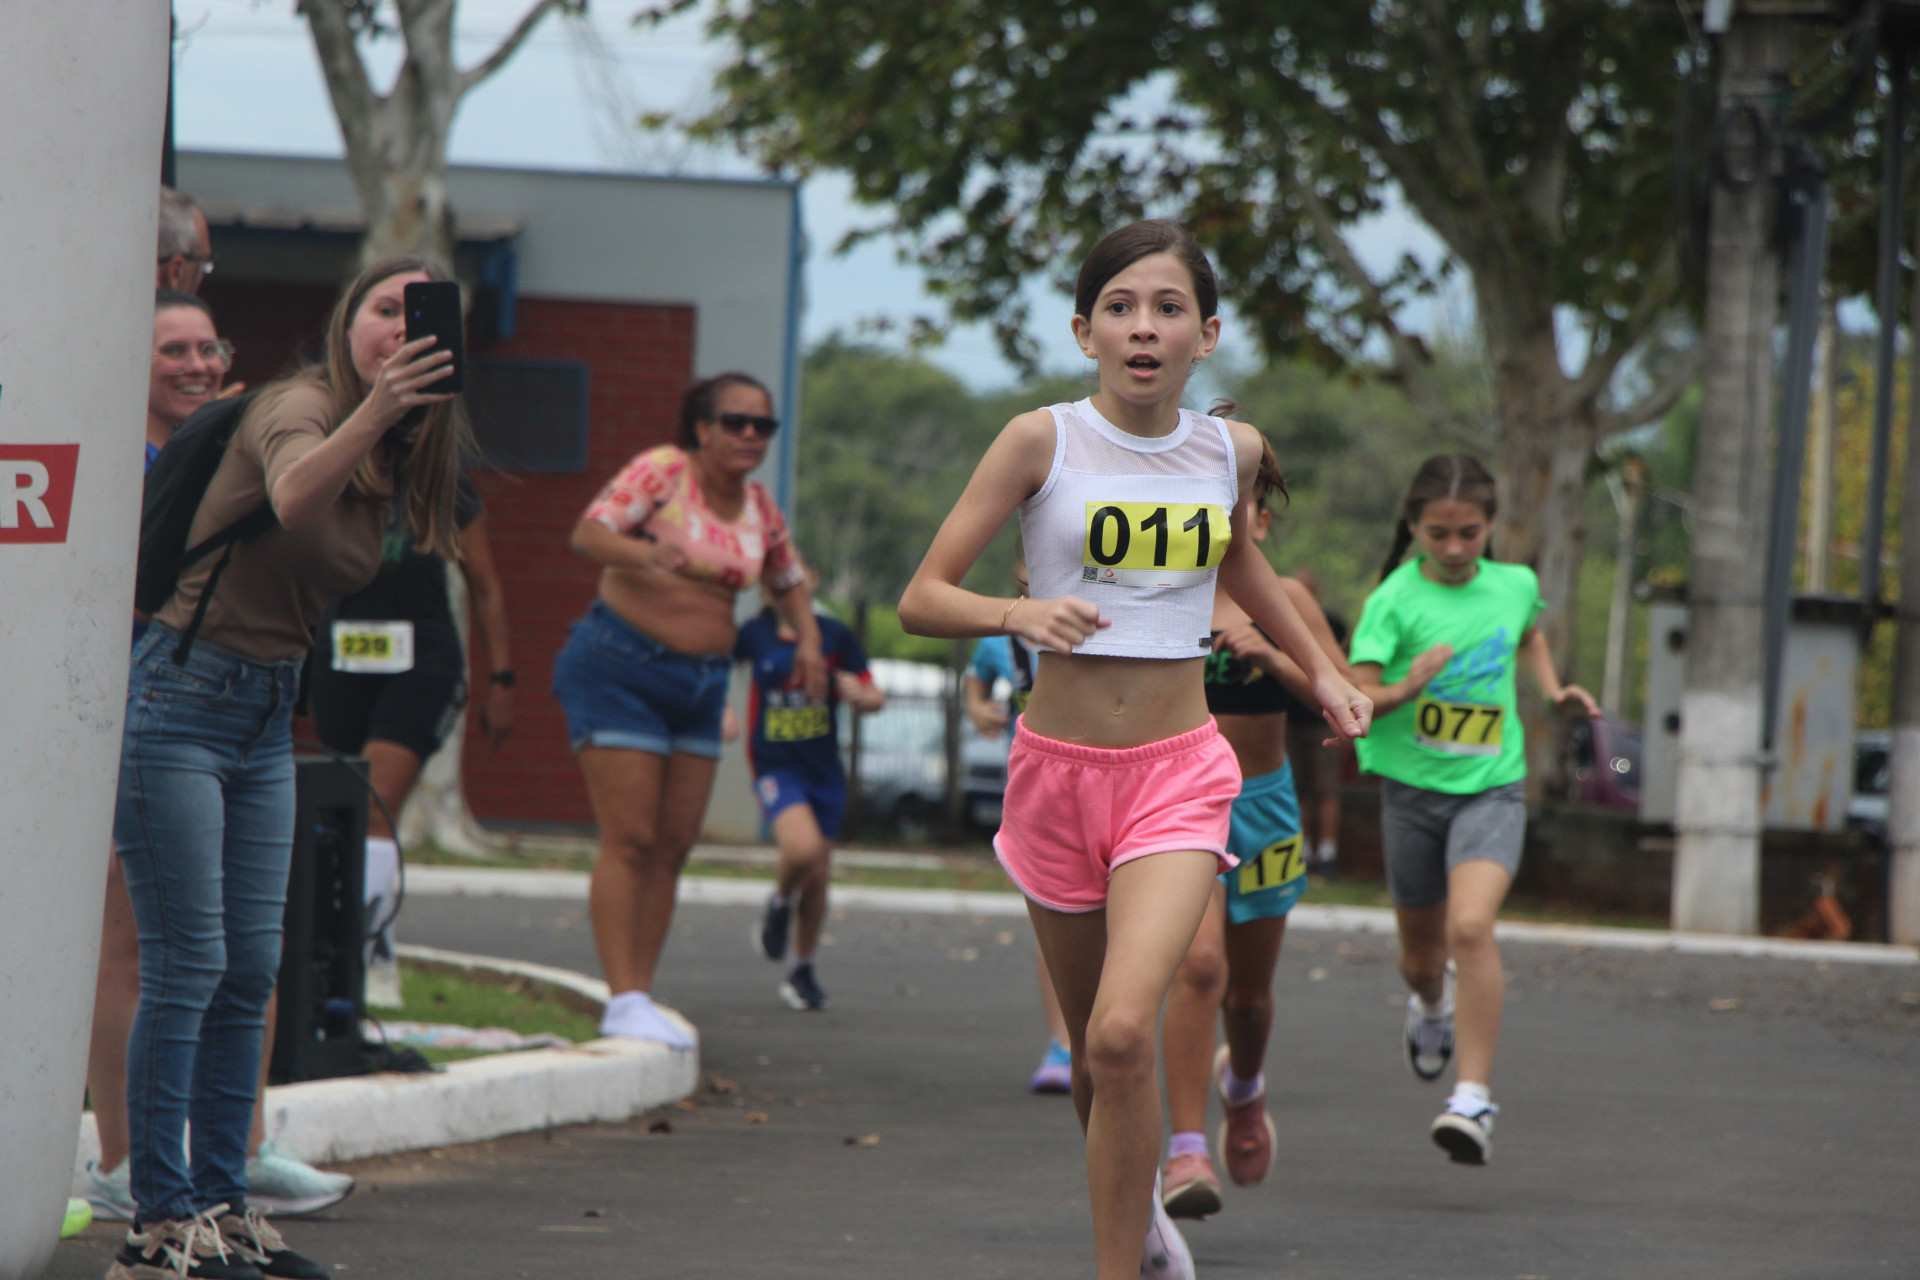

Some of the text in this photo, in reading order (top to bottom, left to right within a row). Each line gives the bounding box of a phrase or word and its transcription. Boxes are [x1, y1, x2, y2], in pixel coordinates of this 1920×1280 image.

[1090, 506, 1211, 567] 011
[1420, 703, 1501, 743] 077
[1249, 844, 1303, 886] 17
